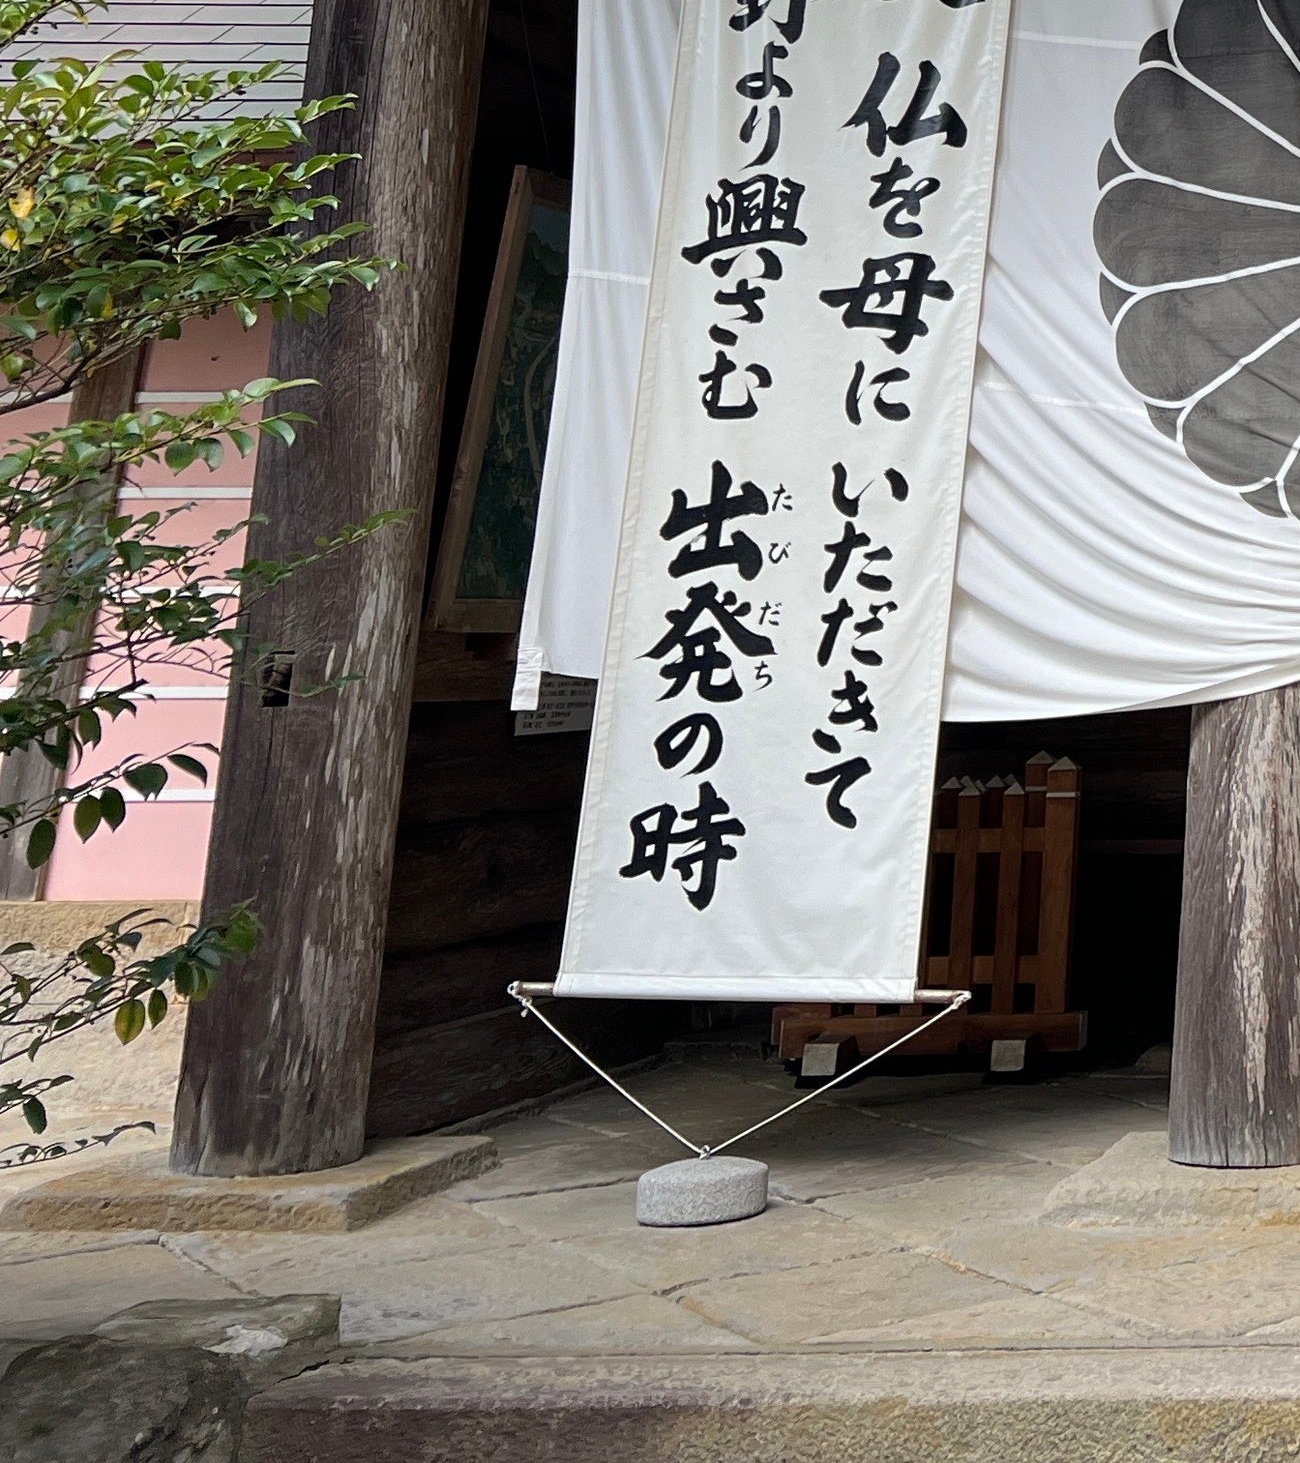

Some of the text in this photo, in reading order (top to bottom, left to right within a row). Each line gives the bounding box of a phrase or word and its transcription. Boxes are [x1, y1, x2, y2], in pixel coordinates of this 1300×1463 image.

[819, 51, 968, 426] 仏を母に
[618, 459, 777, 911] 出発の時
[751, 482, 794, 691] たびだち
[804, 459, 909, 829] いただきて
